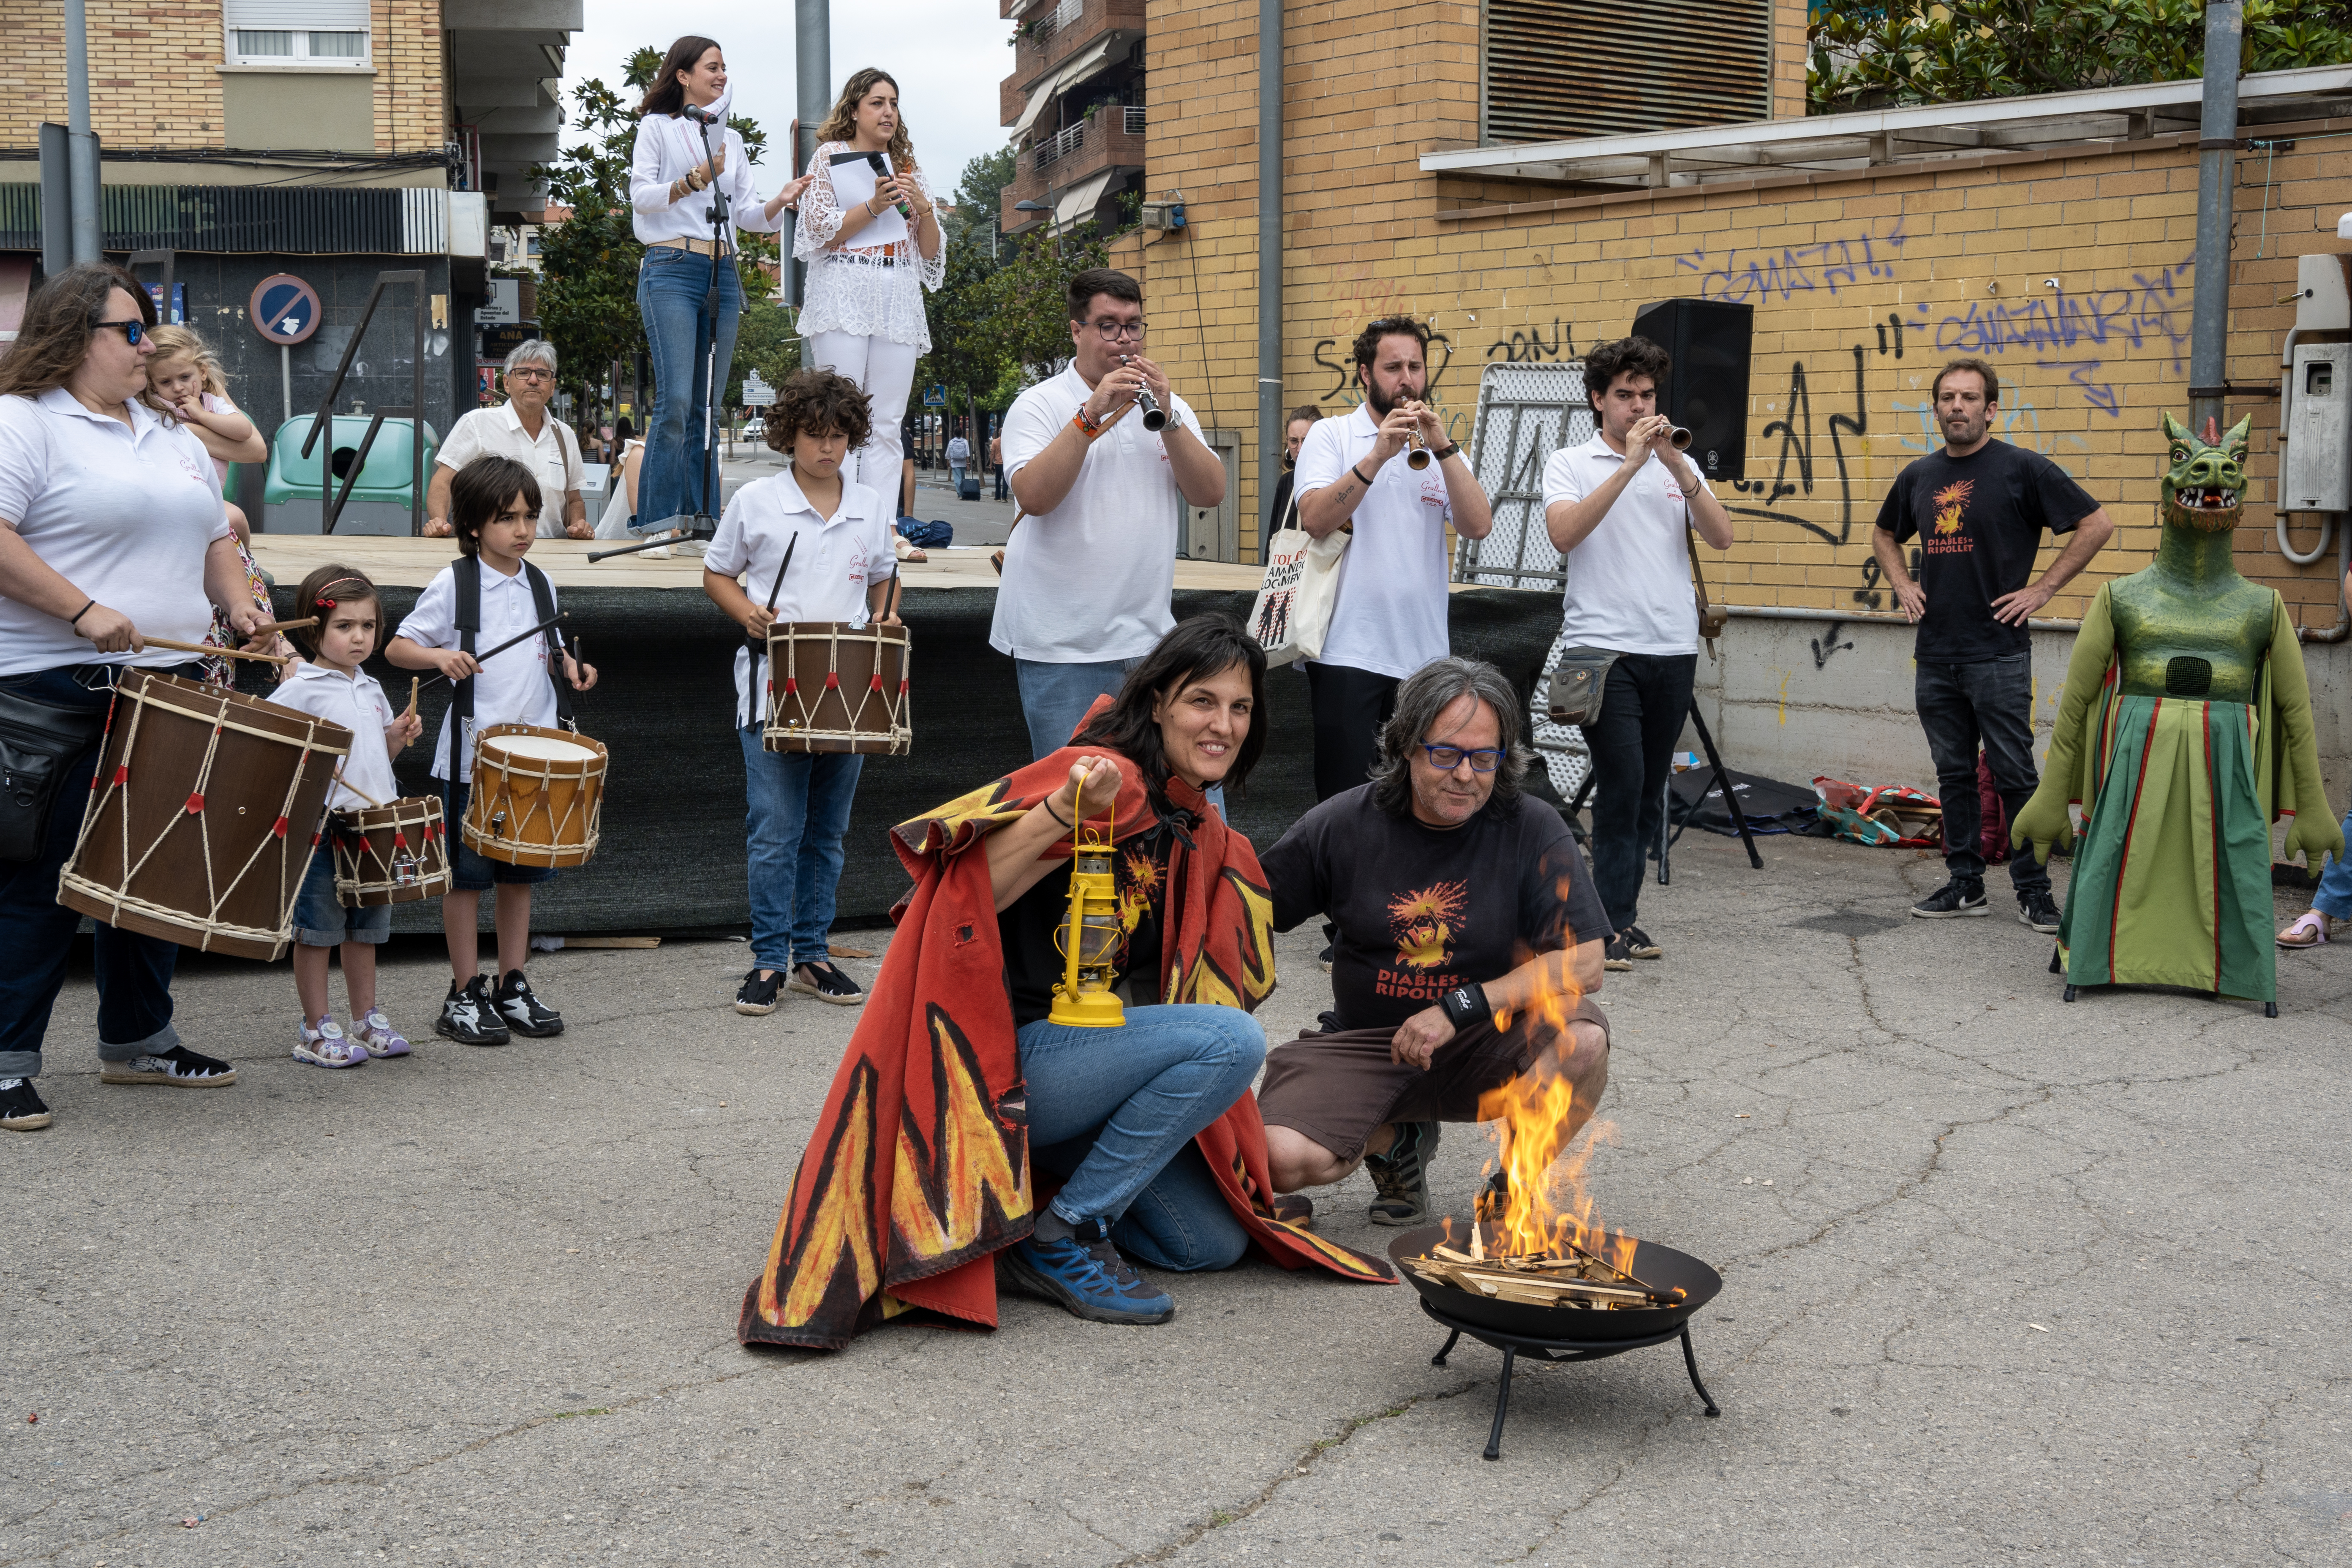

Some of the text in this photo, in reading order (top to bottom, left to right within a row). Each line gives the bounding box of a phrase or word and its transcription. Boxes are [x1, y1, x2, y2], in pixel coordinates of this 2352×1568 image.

[499, 331, 523, 340] ANA
[1421, 481, 1445, 494] Grallers
[1928, 537, 1967, 546] DIABLES
[1928, 544, 1974, 554] RIPOLLET
[1378, 969, 1458, 986] DIABLES
[1376, 982, 1457, 1000] RIPOLL
